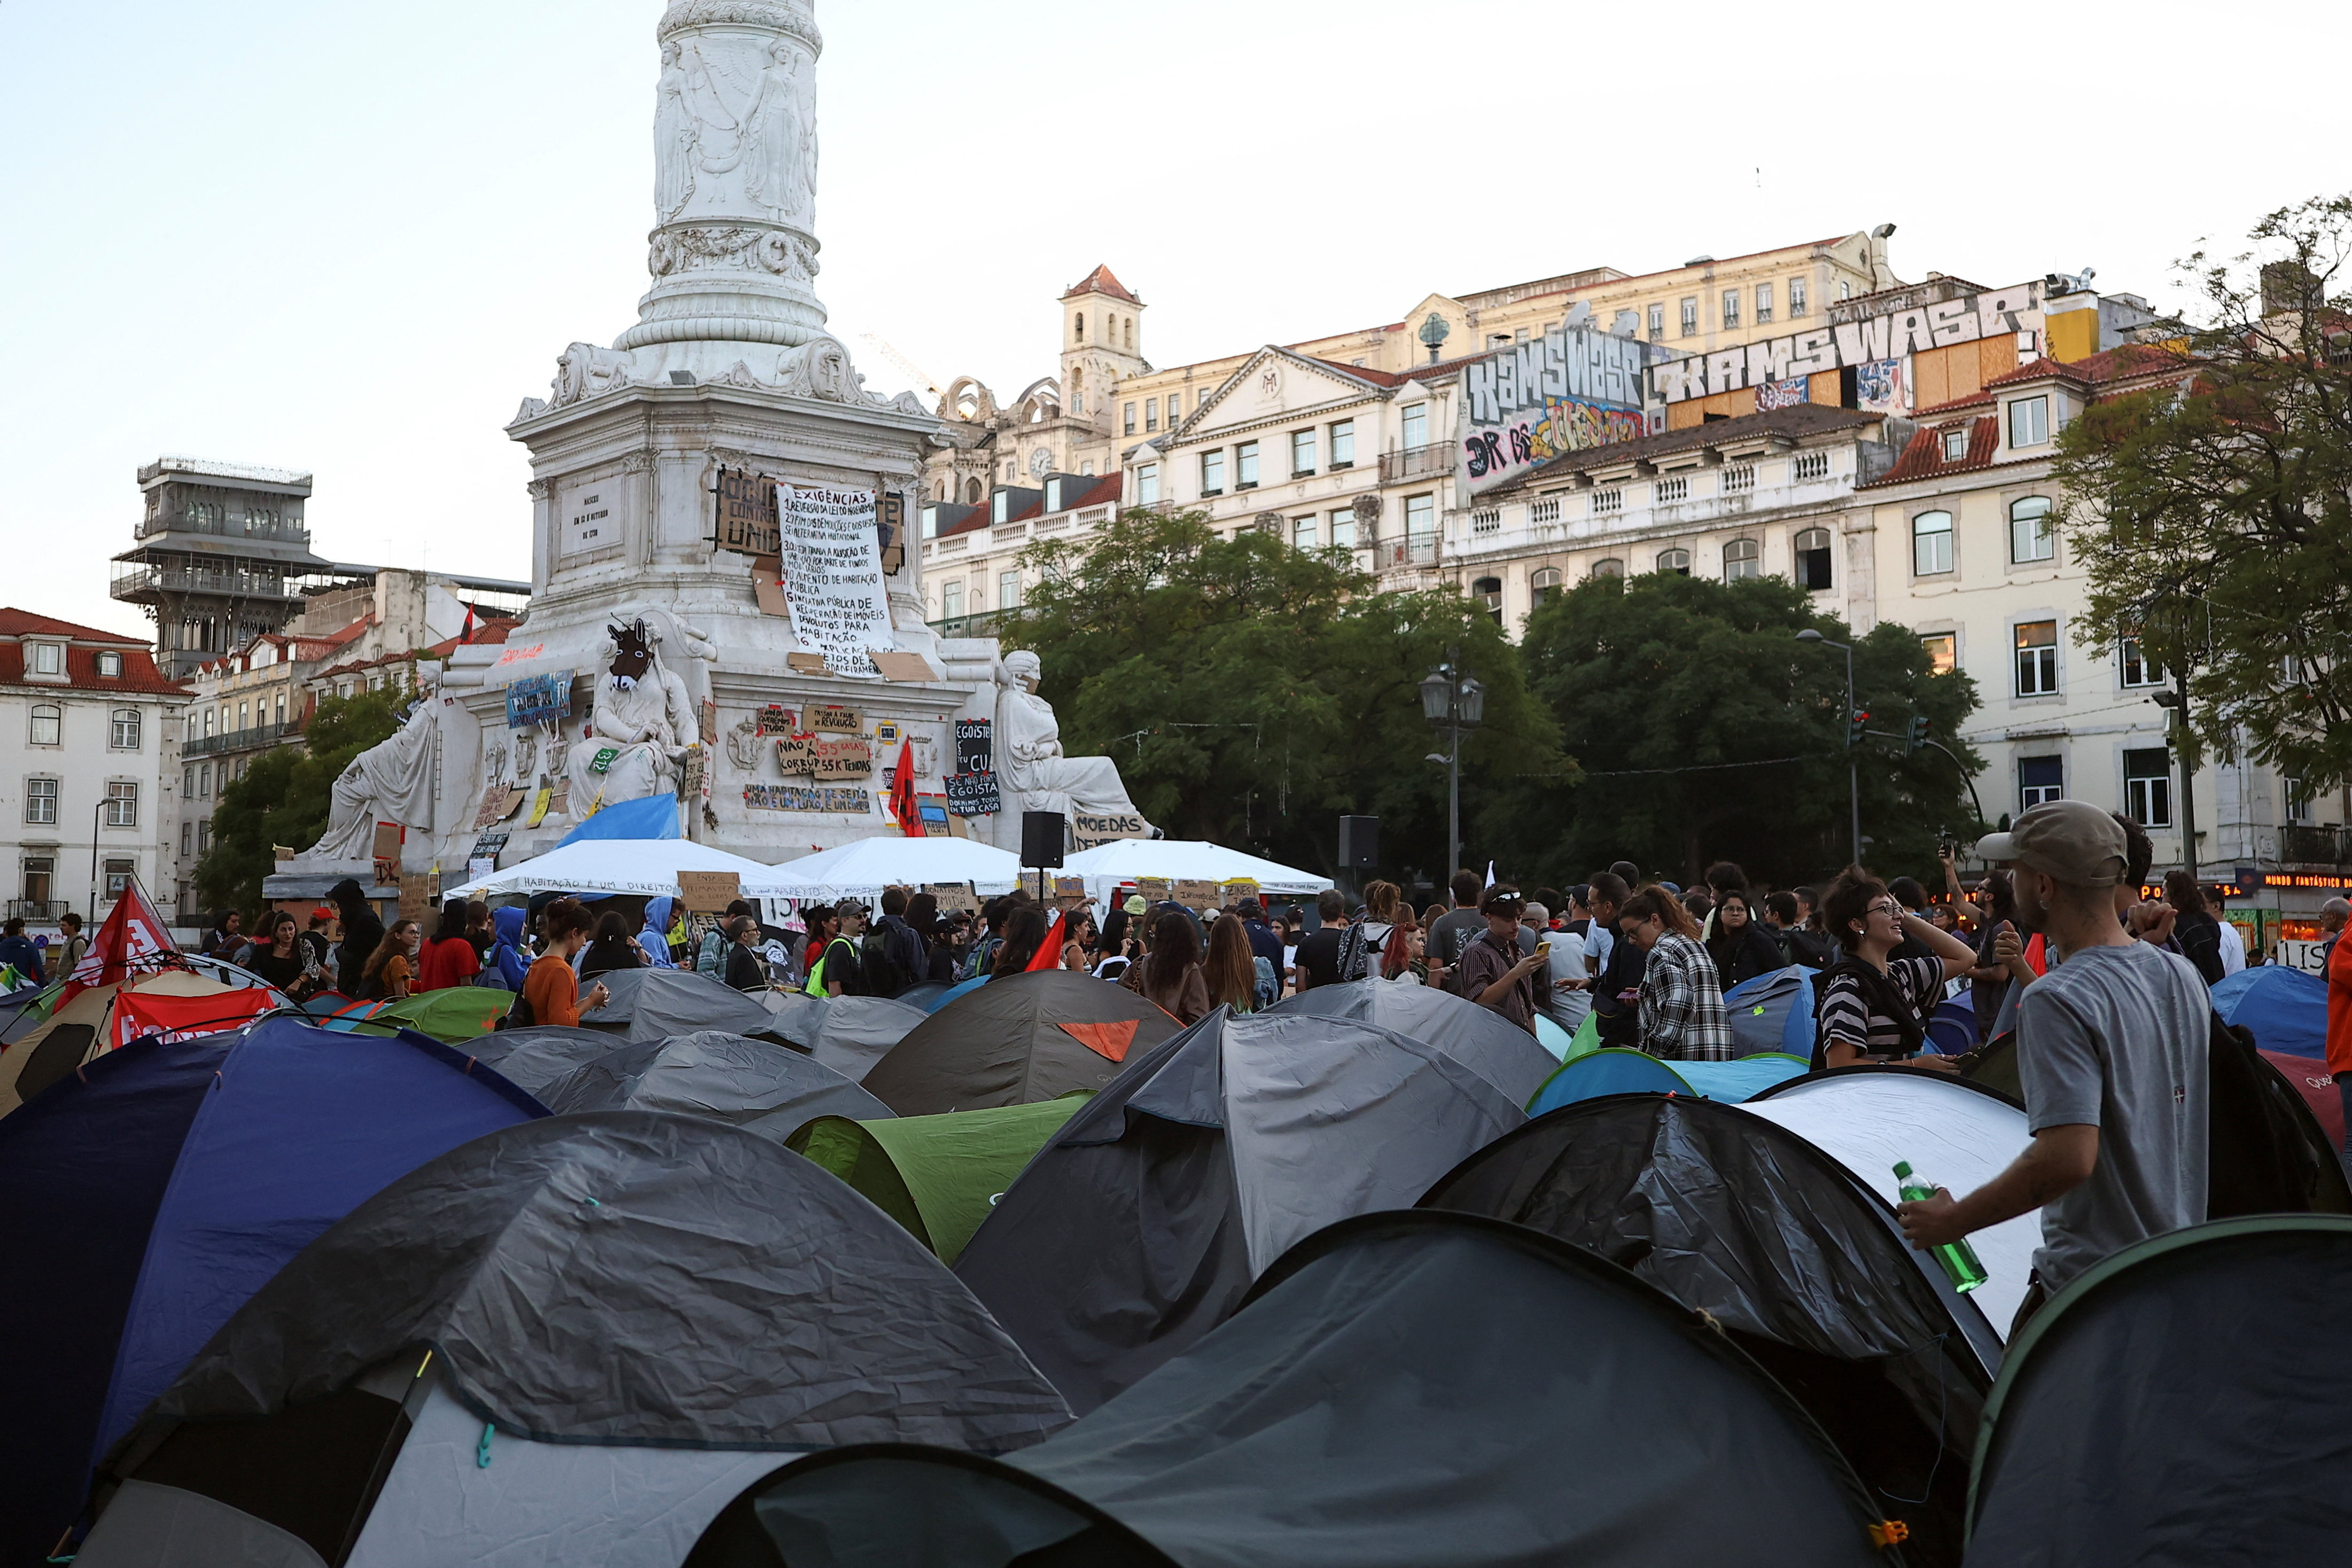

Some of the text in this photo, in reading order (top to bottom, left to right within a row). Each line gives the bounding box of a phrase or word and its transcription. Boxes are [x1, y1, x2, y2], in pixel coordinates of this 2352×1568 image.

[820, 505, 828, 514] DA
[829, 505, 838, 515] LEI
[839, 506, 846, 516] DO
[795, 516, 806, 526] FIM
[852, 521, 862, 531] DOS
[861, 545, 870, 555] DE
[839, 560, 847, 568] DE
[832, 575, 841, 584] DE
[843, 573, 877, 587] HABITAÇÃO
[789, 580, 820, 595] PÚBLICA
[858, 597, 872, 609] DE
[844, 612, 853, 620] DE
[844, 621, 871, 633] PARA
[852, 656, 865, 665] DE
[764, 724, 785, 732] TUDO
[821, 717, 857, 729] REVOLUÇÃO
[970, 754, 987, 771] CU
[960, 806, 976, 814] TUA
[978, 802, 999, 813] CASA
[1076, 816, 1141, 832] MOEDAS
[524, 877, 580, 890] HABITAÇÃO
[600, 881, 616, 890] UM
[2265, 874, 2292, 886] MUNDO
[2295, 875, 2340, 888] FANTÁSTICO
[925, 886, 966, 895] DONATIVOS
[1227, 885, 1251, 896] ZINES
